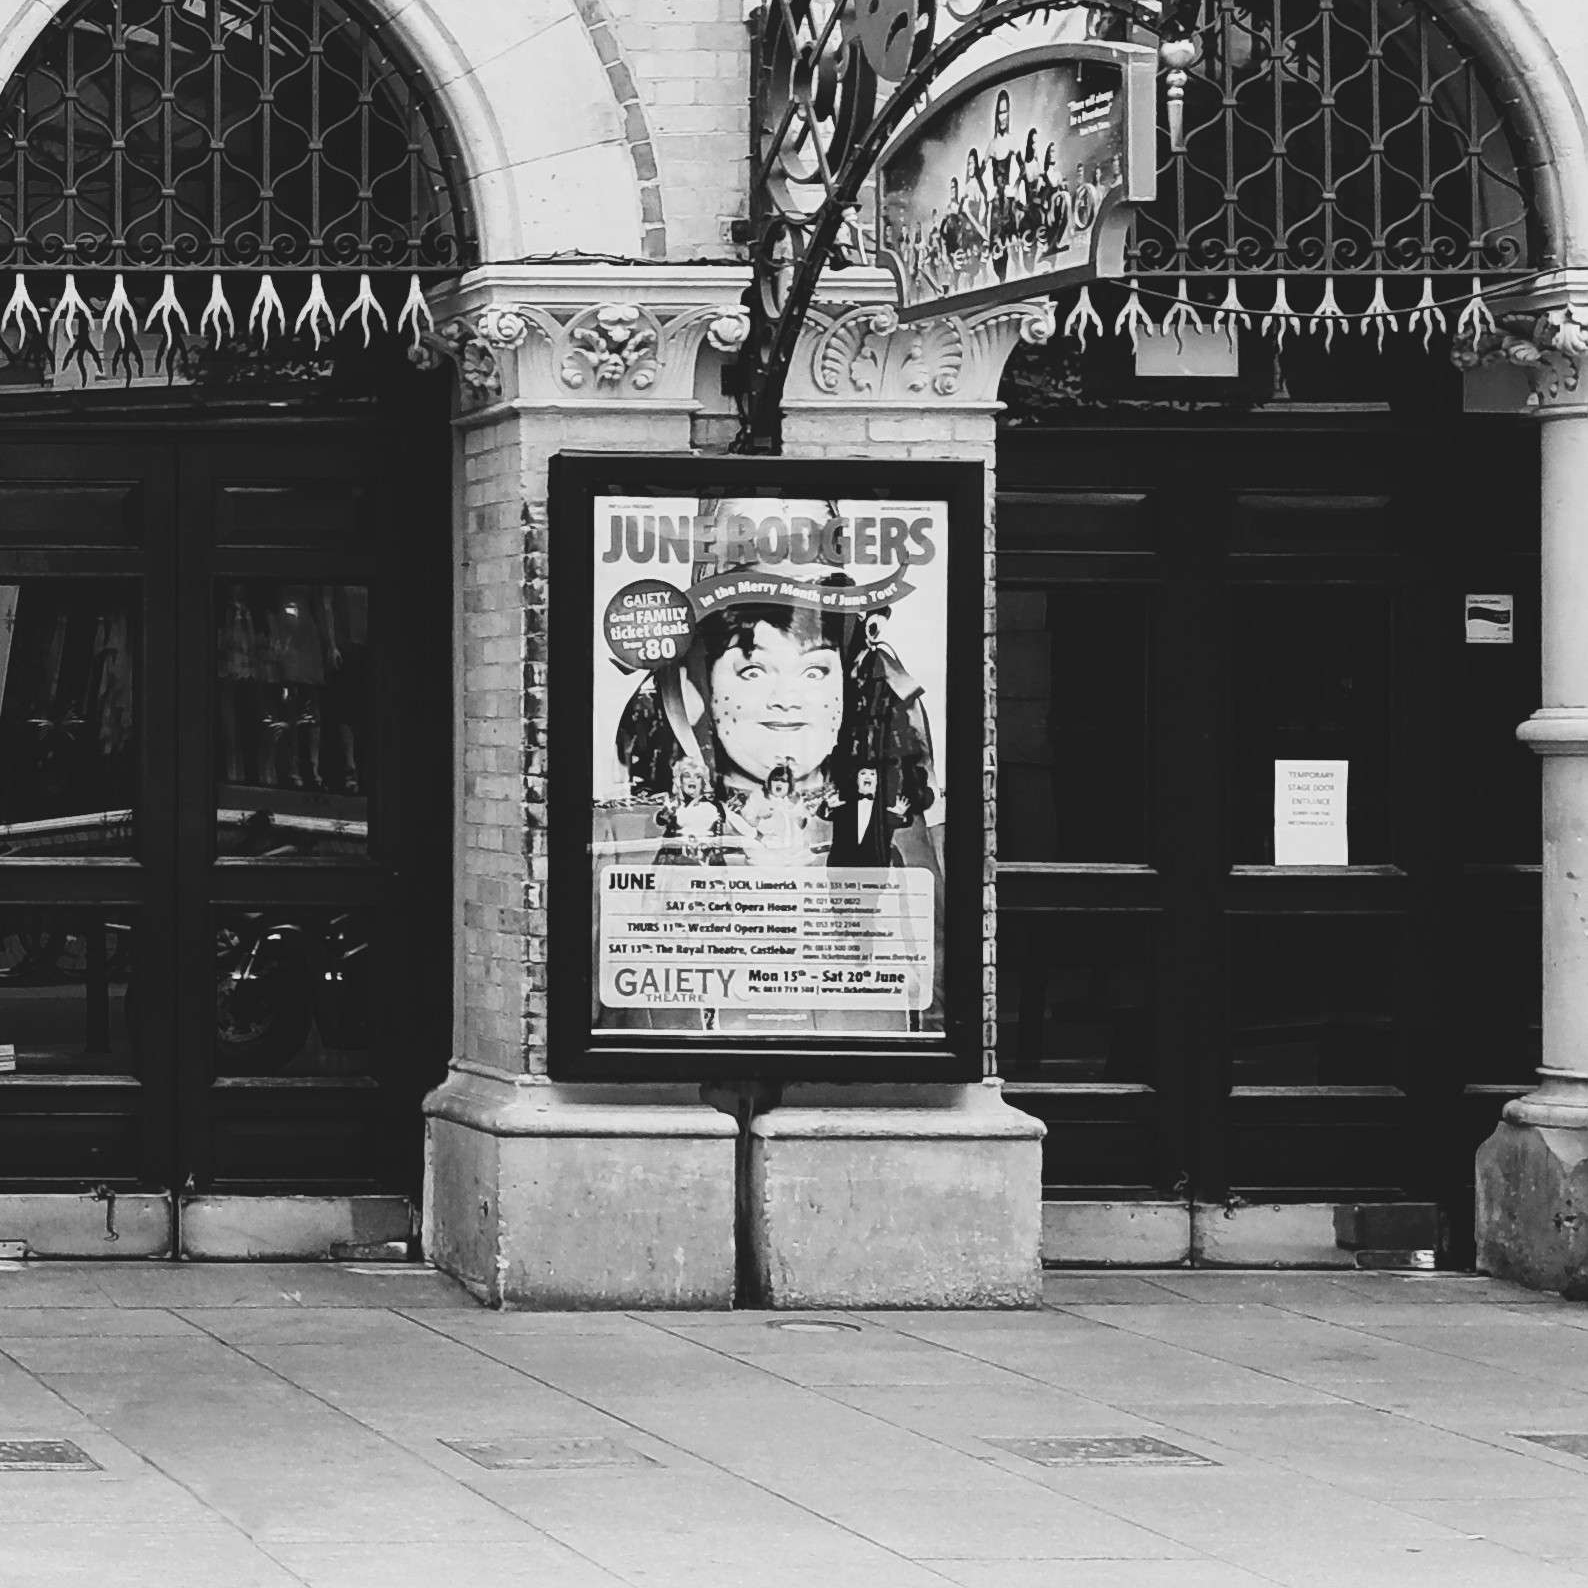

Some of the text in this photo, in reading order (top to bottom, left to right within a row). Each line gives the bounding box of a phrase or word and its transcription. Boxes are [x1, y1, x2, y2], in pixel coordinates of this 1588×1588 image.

[602, 515, 936, 565] JUNE RODGERS
[623, 591, 671, 608] GAIETY
[699, 580, 898, 608] In the Merry Month of June Tour
[636, 606, 688, 624] FAMILY
[610, 620, 690, 640] ticket deals
[637, 637, 676, 661] €80
[1288, 771, 1334, 779] TEMPORARY
[1288, 783, 1335, 791] STAGE DOOR
[1292, 797, 1330, 805] ENTRANCE
[609, 873, 656, 890] JUNE
[691, 880, 706, 889] FRI
[755, 880, 798, 890] Limerick
[666, 901, 685, 911] SAT
[708, 902, 732, 912] Cork
[735, 902, 764, 913] Opera
[768, 903, 798, 912] House
[627, 922, 659, 932] THURS
[688, 923, 731, 933] Wexford
[734, 923, 764, 934] Opera
[767, 924, 798, 934] House
[609, 944, 628, 953] SAT
[656, 944, 673, 953] The
[676, 944, 704, 956] Royal
[707, 944, 747, 955] Theatre,
[750, 944, 796, 955] Castlebar
[614, 968, 736, 998] GAIETY
[748, 970, 779, 983] Mon
[784, 969, 806, 983] 15th
[822, 970, 843, 983] Sat
[847, 970, 871, 983] 20th
[875, 971, 905, 983] June
[645, 993, 705, 1003] THEATRE
